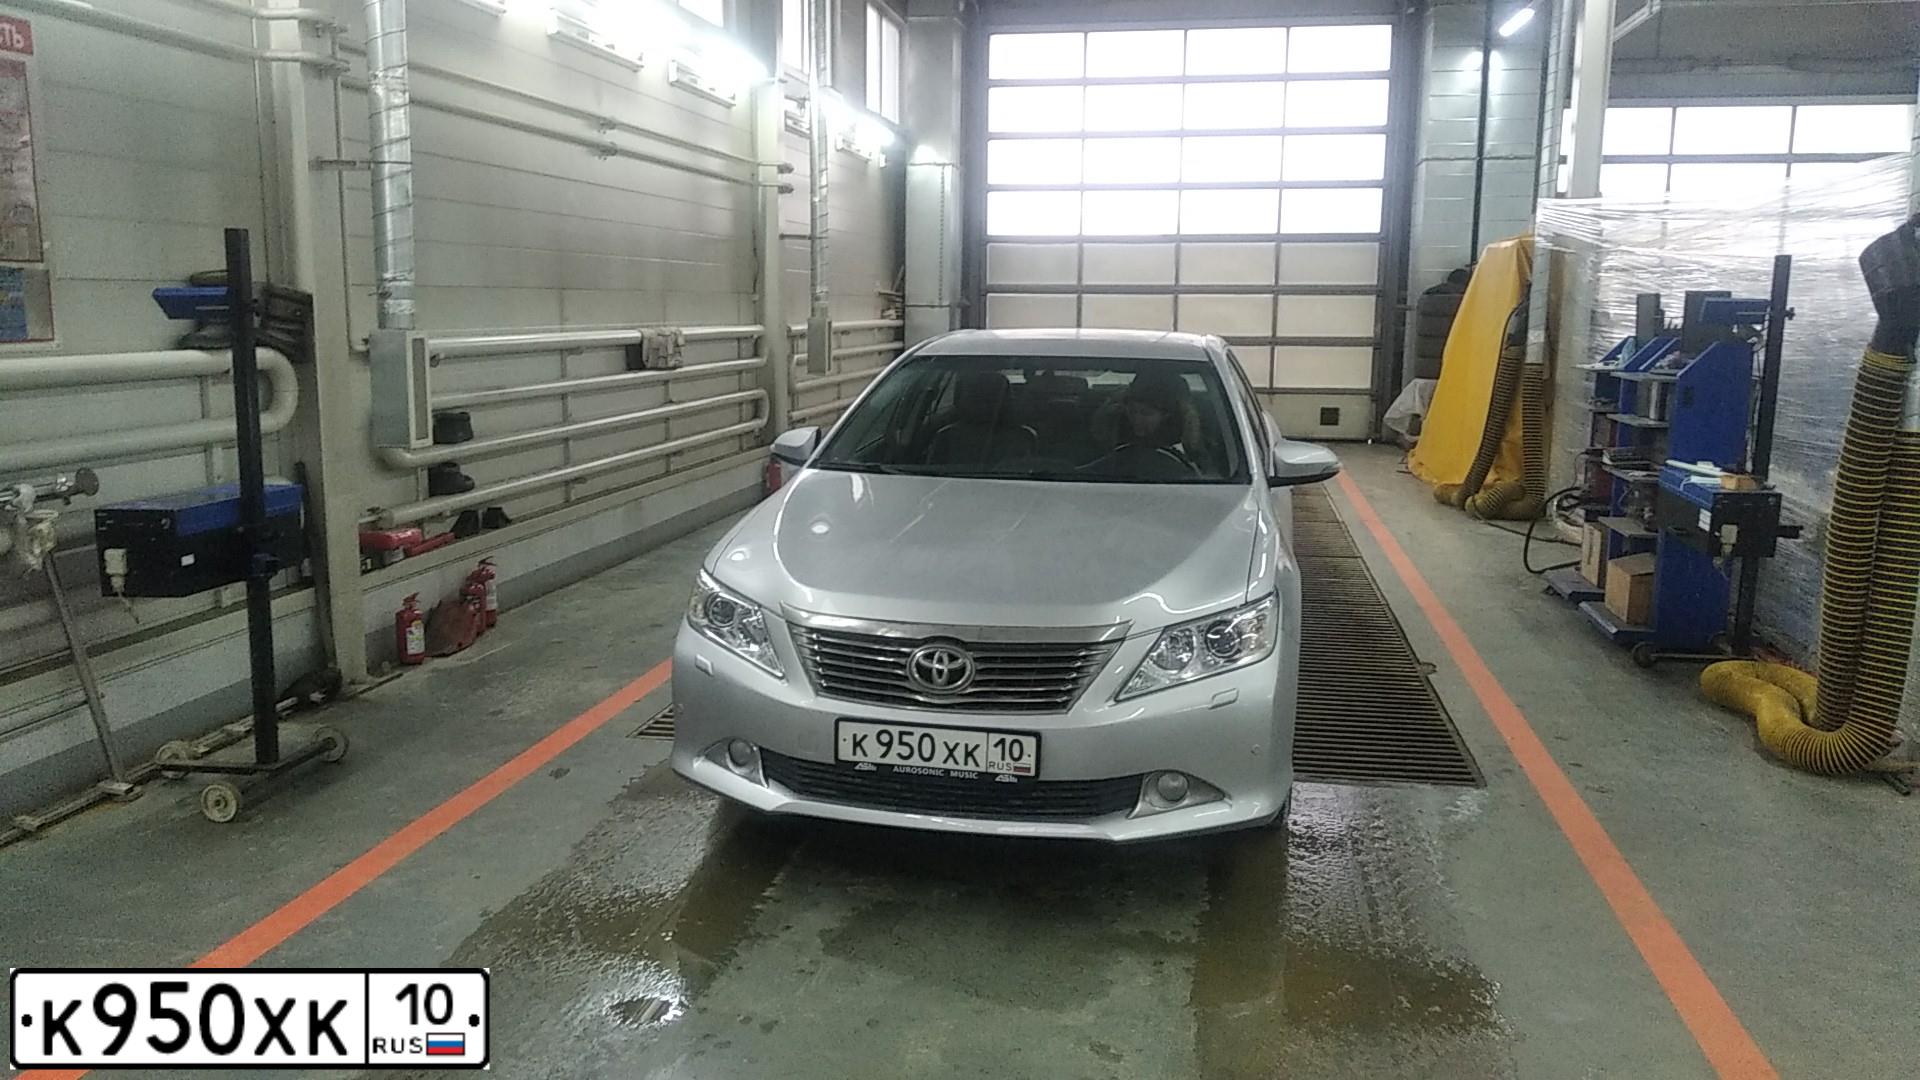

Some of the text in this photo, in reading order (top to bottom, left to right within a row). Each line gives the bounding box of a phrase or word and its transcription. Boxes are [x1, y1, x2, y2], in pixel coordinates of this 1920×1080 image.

[0, 23, 25, 49] ТЬ
[993, 737, 1024, 762] 10
[950, 771, 979, 780] MUSIC
[988, 761, 1013, 772] RUS
